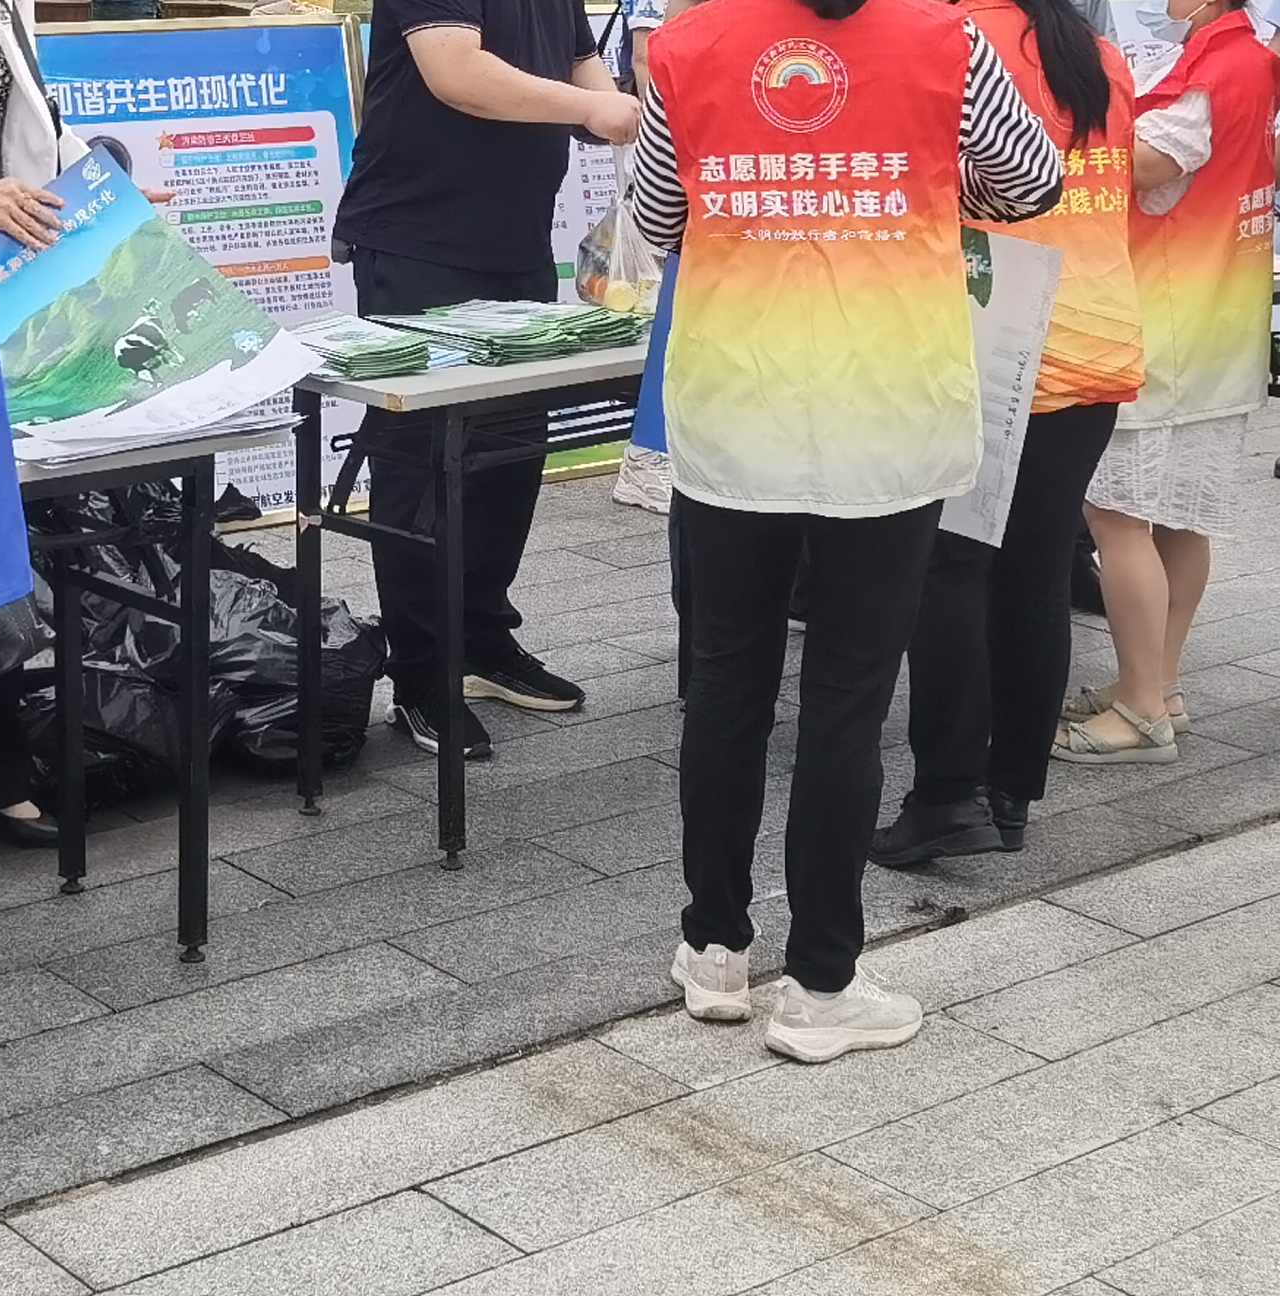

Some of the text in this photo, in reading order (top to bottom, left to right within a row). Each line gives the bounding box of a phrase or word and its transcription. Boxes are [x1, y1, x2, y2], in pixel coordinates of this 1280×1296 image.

[699, 151, 910, 182] 志愿服务手牵手
[700, 189, 909, 219] 文明实践心连心
